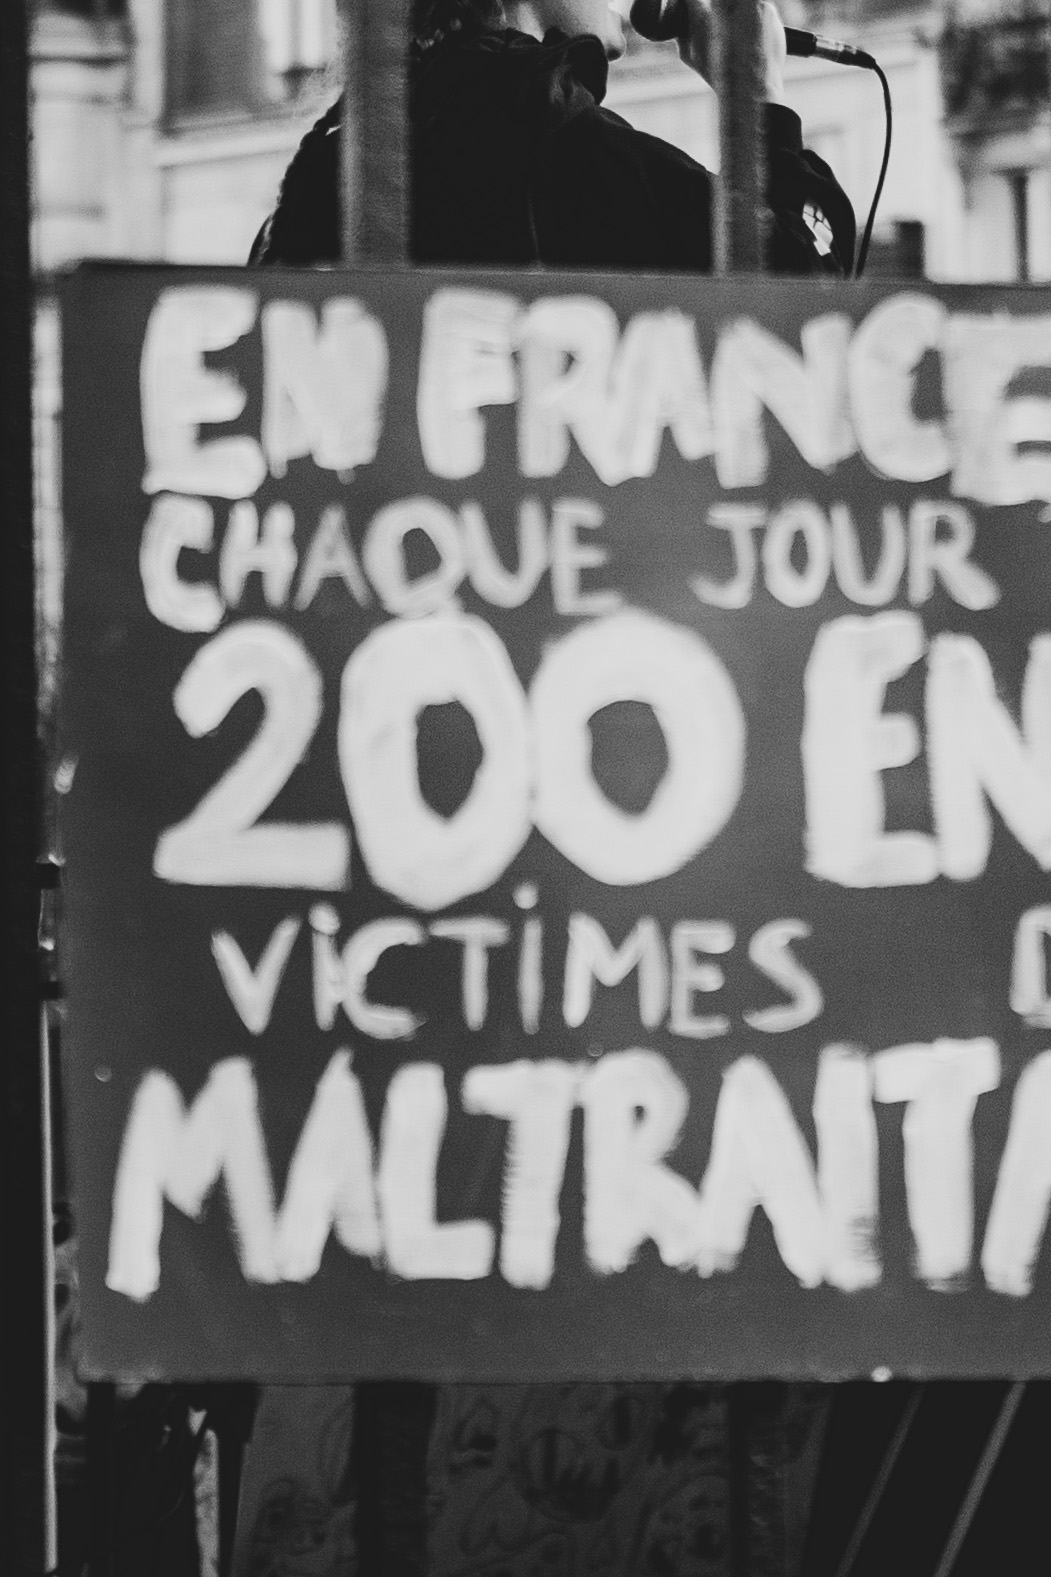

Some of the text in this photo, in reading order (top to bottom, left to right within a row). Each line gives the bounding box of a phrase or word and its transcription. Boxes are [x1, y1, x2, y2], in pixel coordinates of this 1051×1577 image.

[140, 287, 388, 499] EN
[140, 494, 999, 631] CHAQUE JOUR
[153, 610, 745, 911] 200
